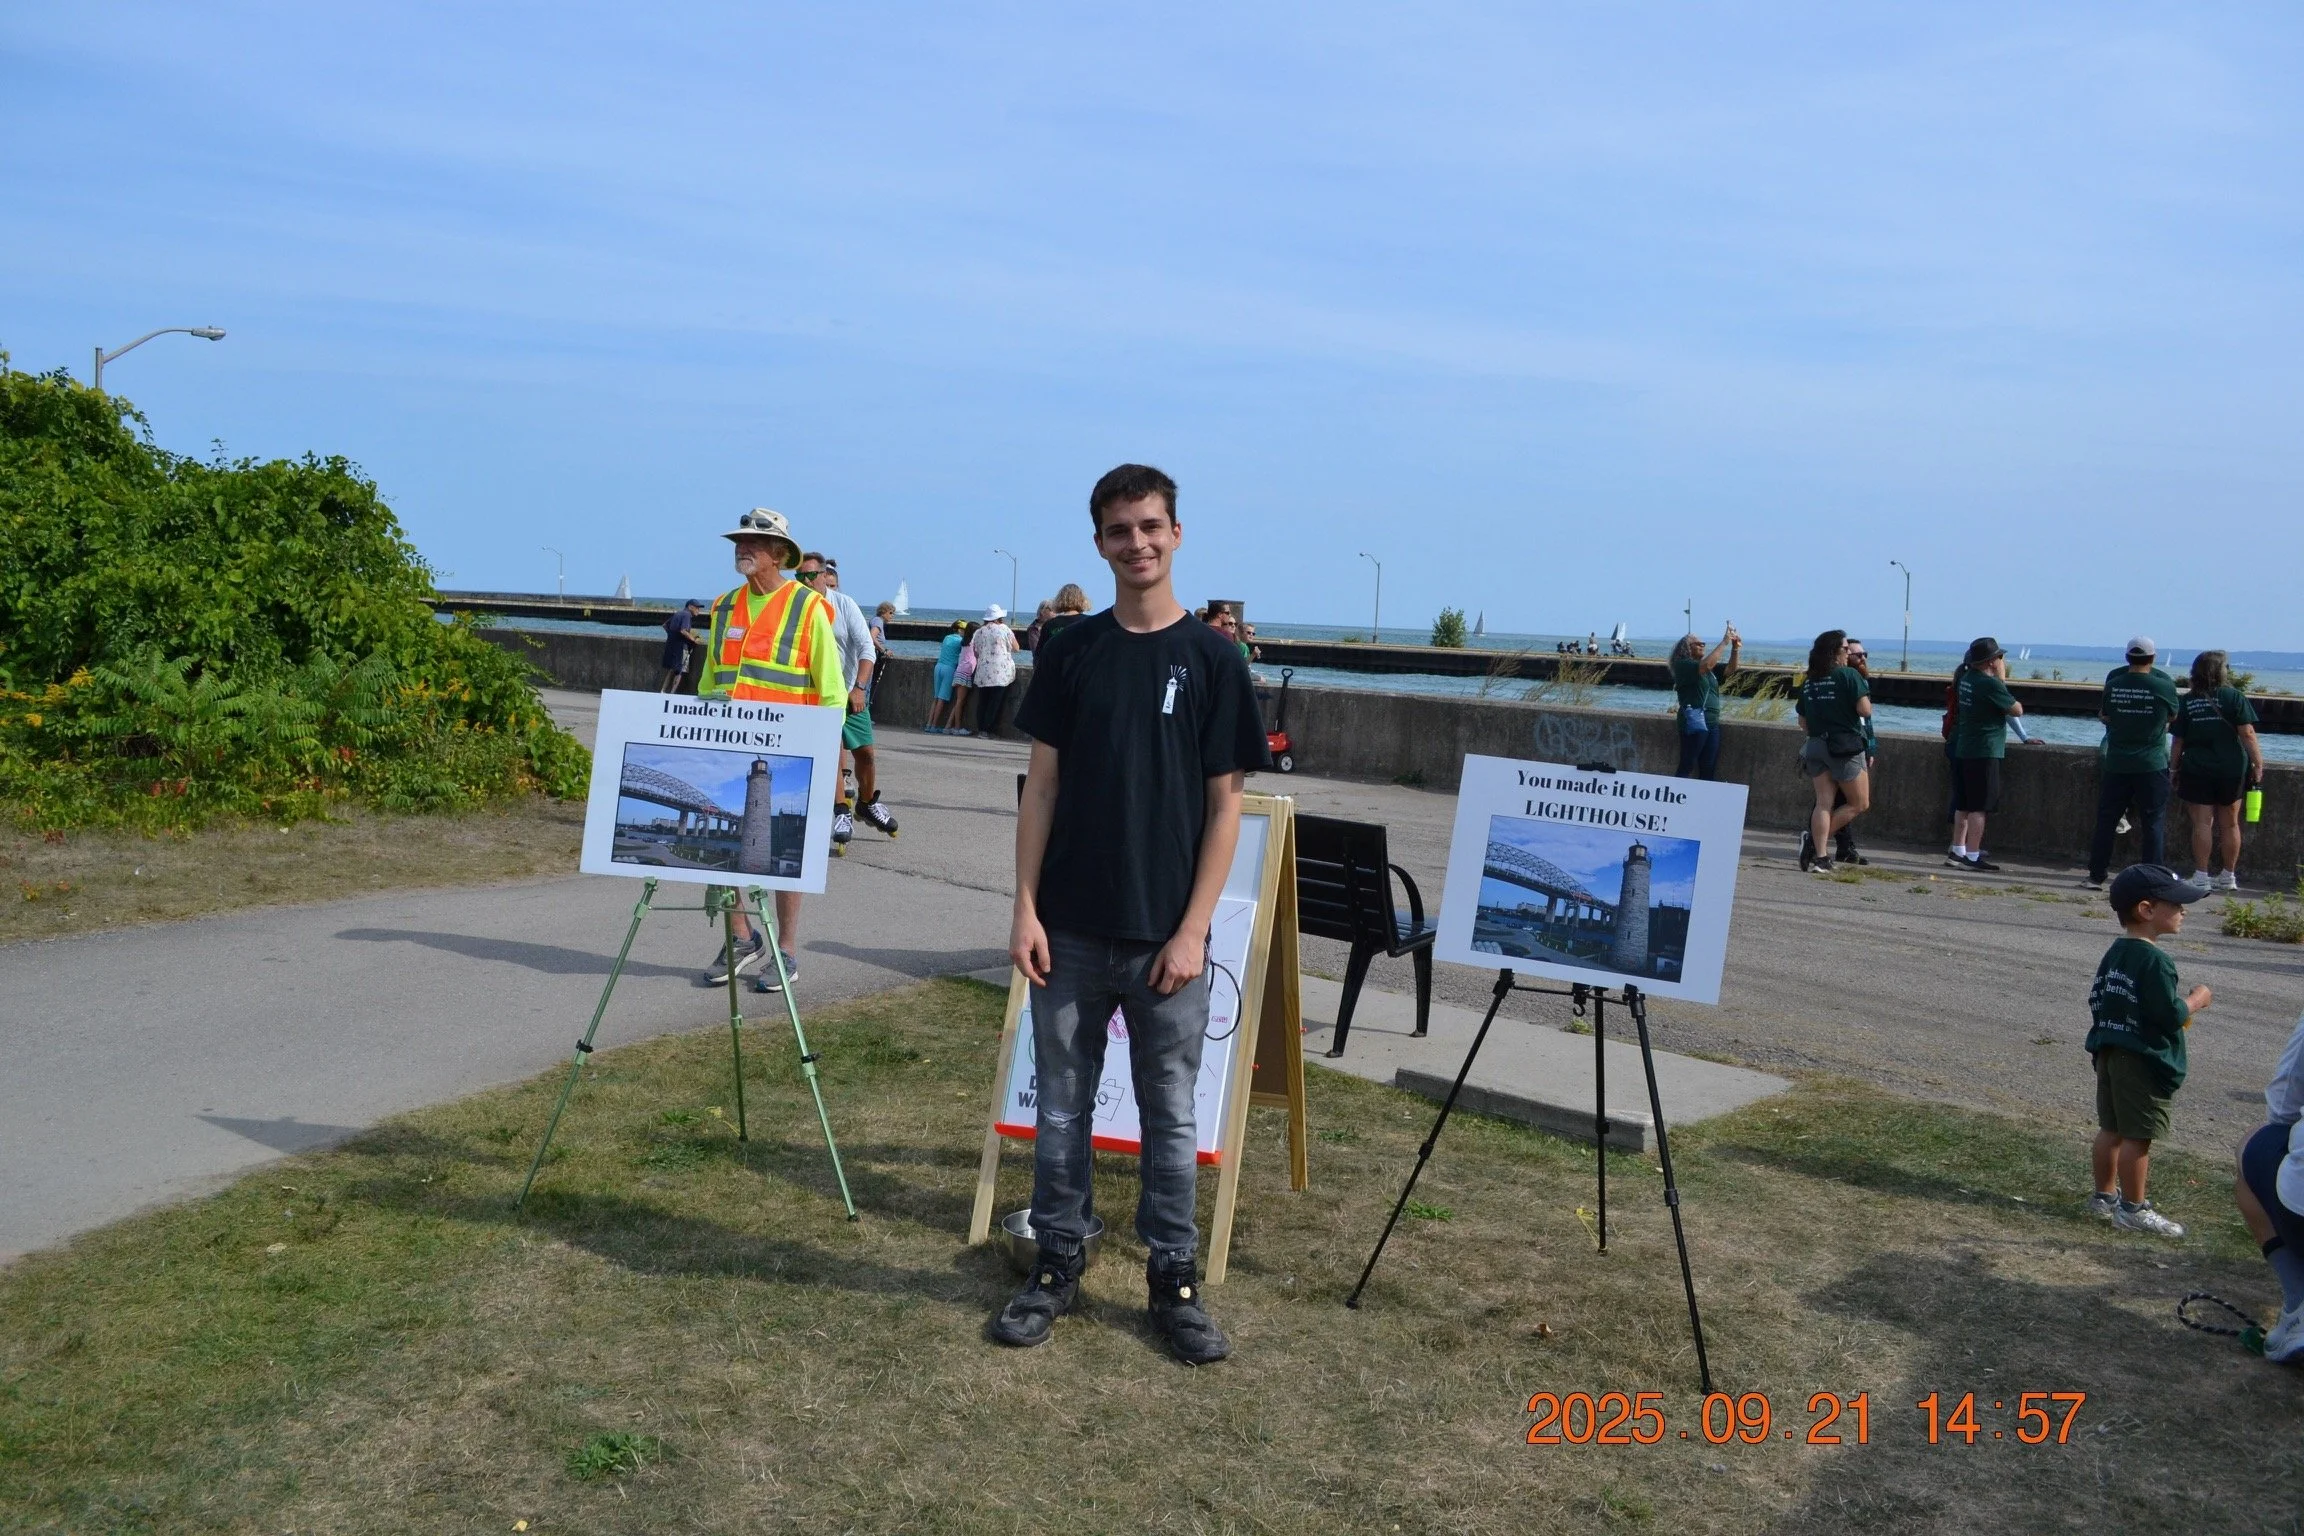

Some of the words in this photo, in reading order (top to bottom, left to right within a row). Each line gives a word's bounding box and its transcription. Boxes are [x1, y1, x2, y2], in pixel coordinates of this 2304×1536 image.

[663, 700, 670, 714] I
[673, 702, 718, 718] made
[721, 704, 734, 719] it
[738, 707, 754, 720] to
[757, 707, 785, 723] the
[659, 724, 782, 748] LIGHTHOUSE!
[1517, 770, 1551, 789] You
[1556, 778, 1608, 796] made
[1612, 780, 1626, 798] it
[1631, 785, 1650, 801] to
[1655, 786, 1687, 805] the
[1525, 800, 1668, 832] LIGHTHOUSE!
